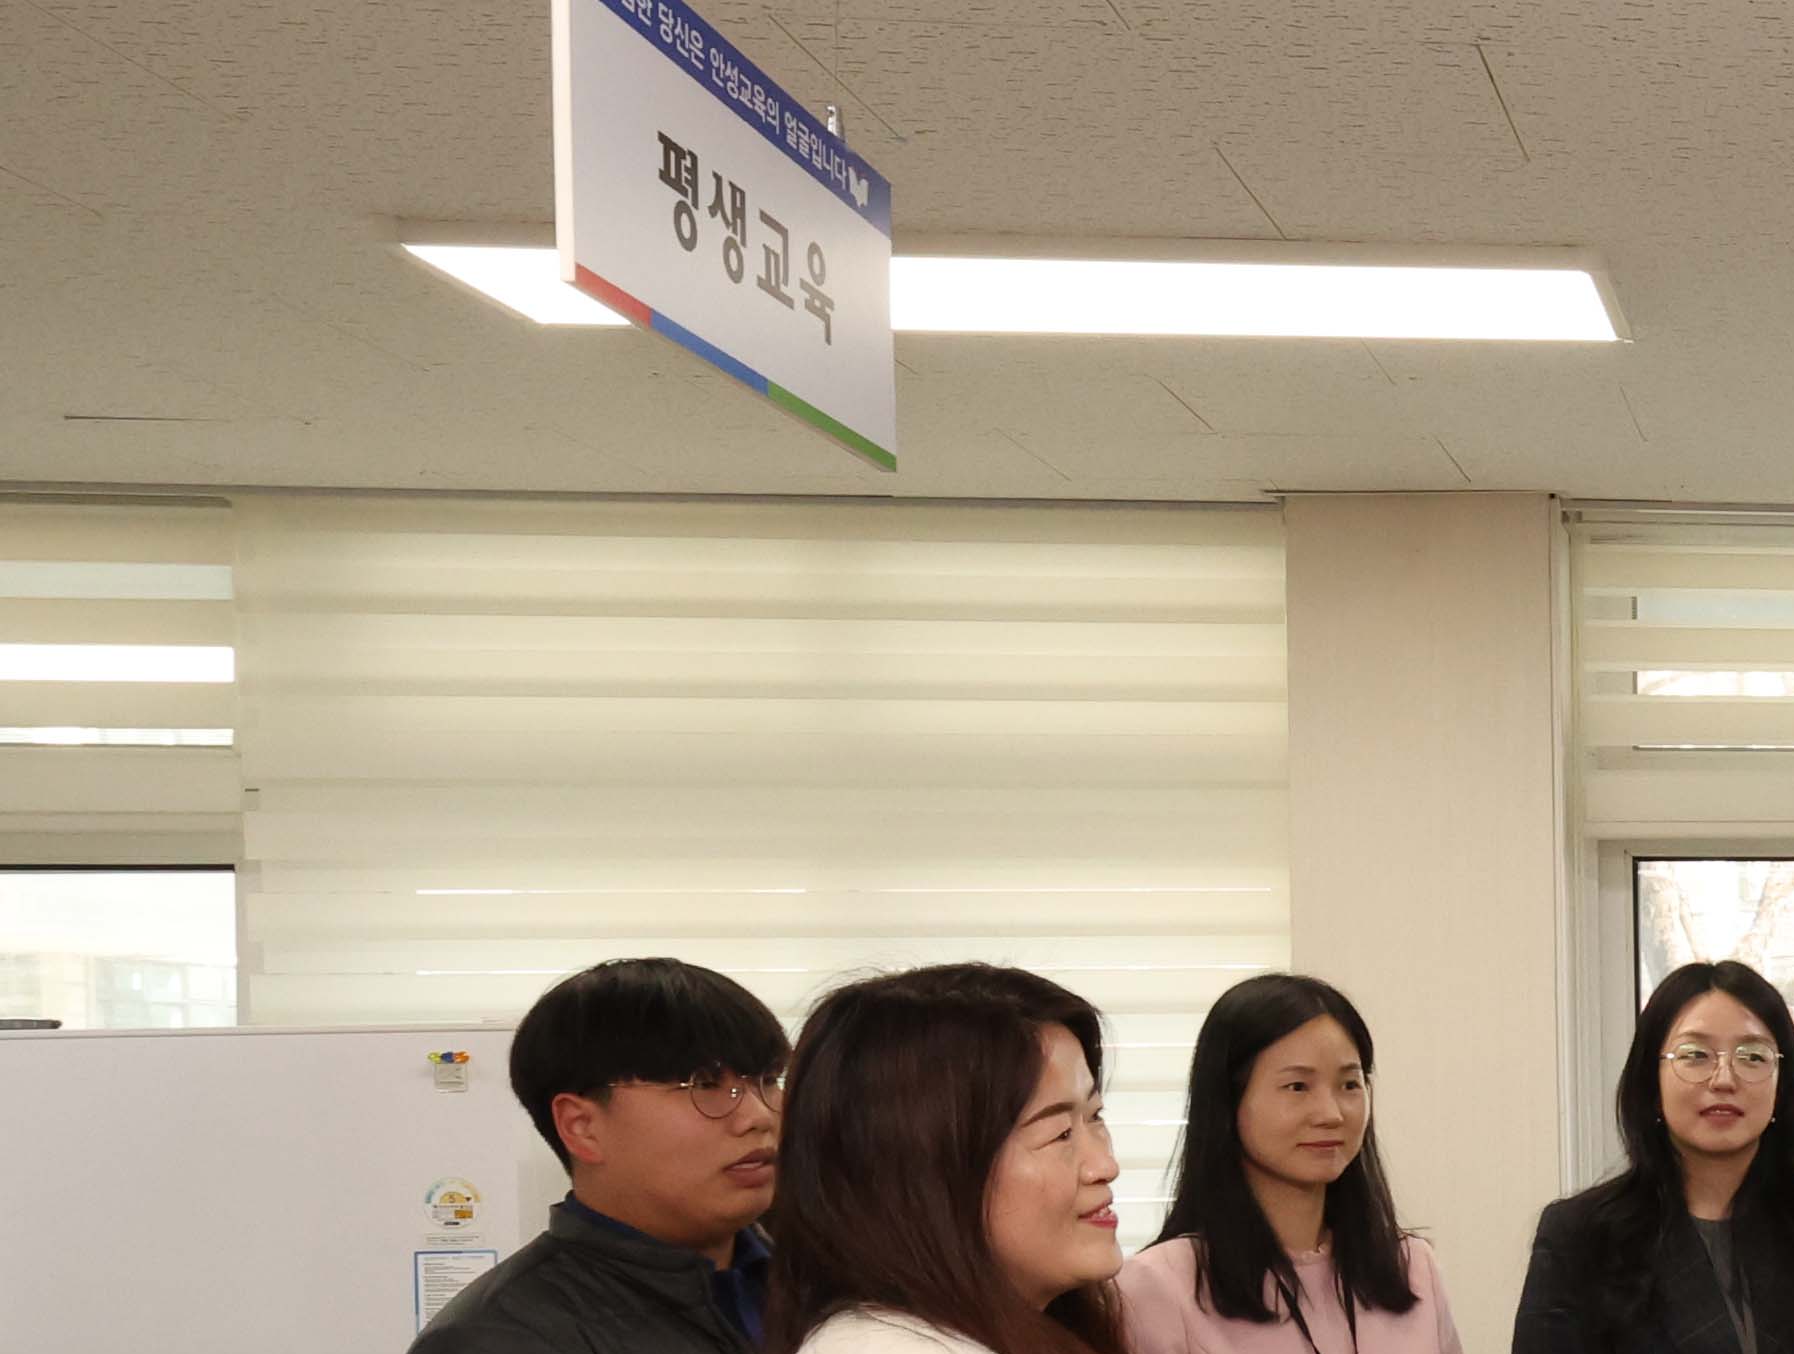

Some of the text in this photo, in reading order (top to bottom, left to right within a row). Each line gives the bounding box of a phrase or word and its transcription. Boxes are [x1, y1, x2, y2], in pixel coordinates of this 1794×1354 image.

[658, 2, 704, 70] 당신은
[710, 48, 780, 135] 안성교육의
[784, 110, 847, 191] 얼굴입니다
[657, 131, 835, 346] 평생교육
